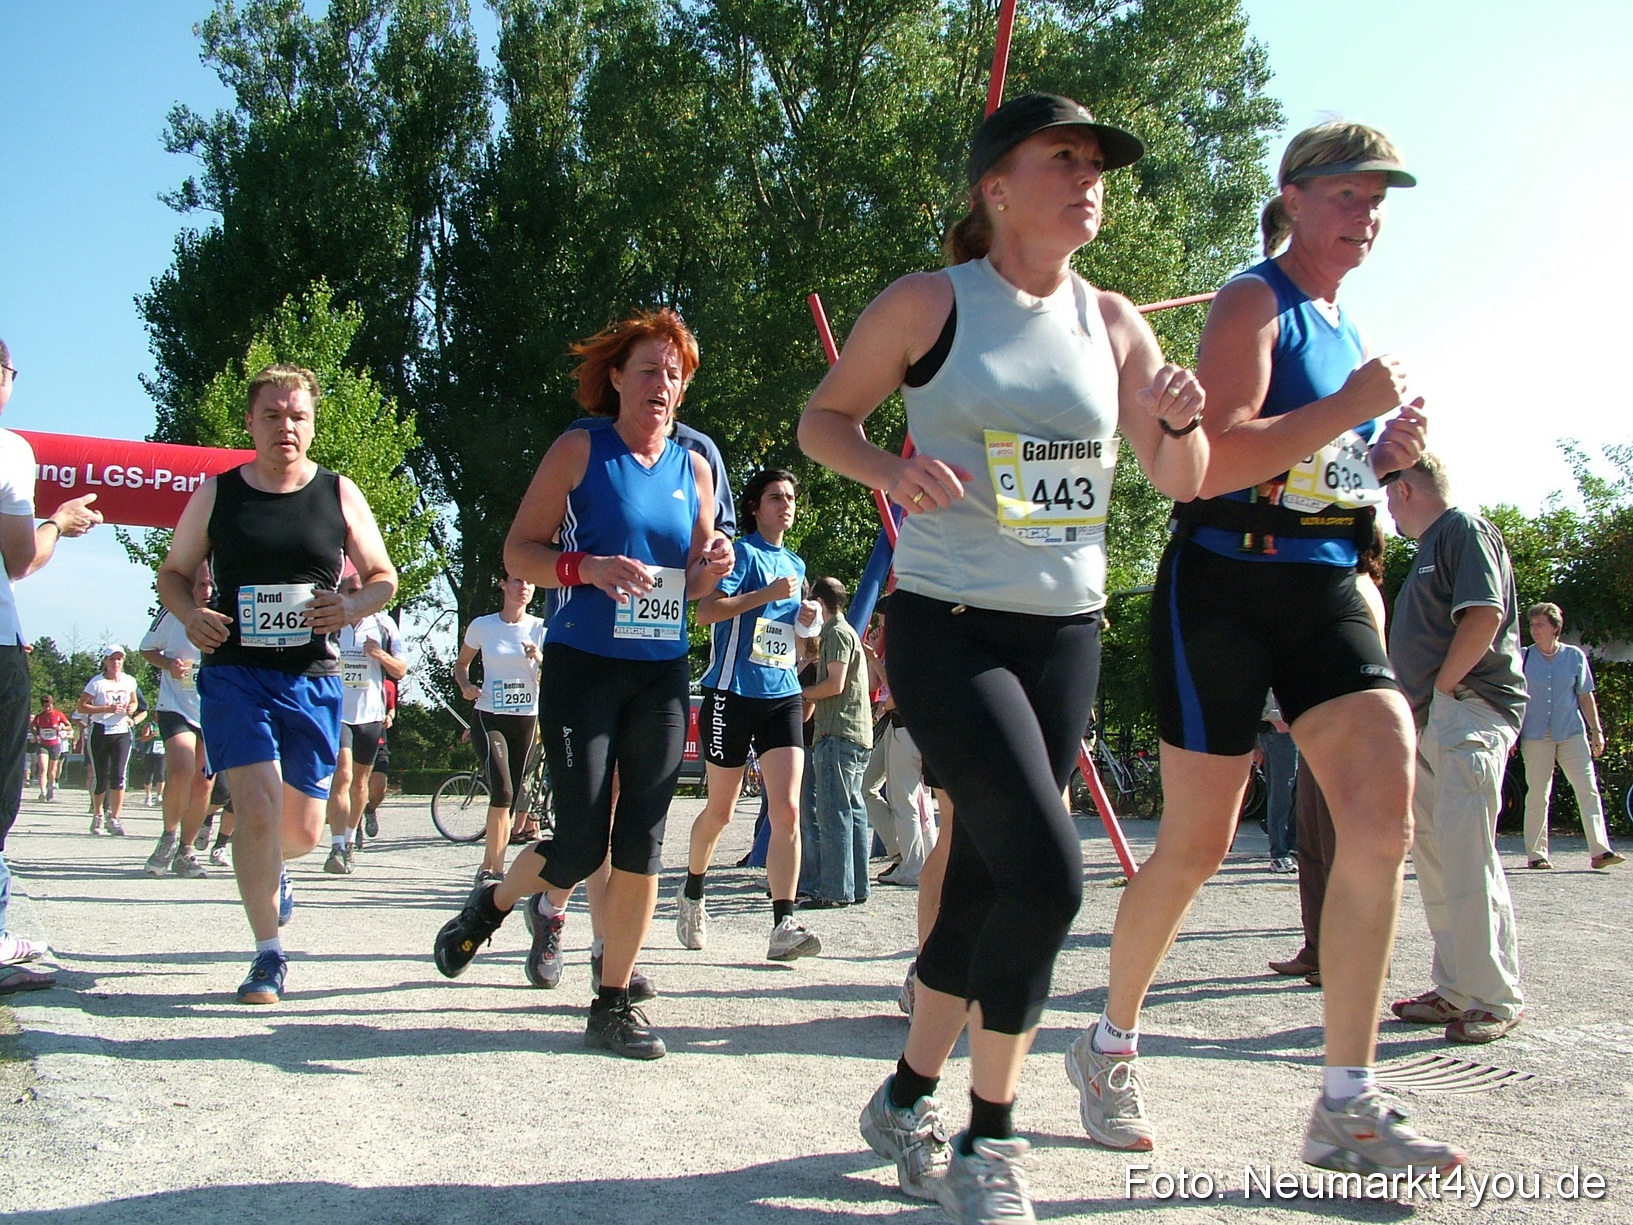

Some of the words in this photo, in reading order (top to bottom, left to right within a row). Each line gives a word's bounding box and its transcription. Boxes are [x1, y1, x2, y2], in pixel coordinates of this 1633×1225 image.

[1023, 441, 1102, 461] Gabriele
[1000, 473, 1014, 490] C
[1032, 477, 1095, 510] 443
[257, 591, 282, 603] Arnd
[243, 608, 251, 618] C
[638, 598, 680, 620] 2946
[765, 625, 782, 635] Liane
[766, 640, 787, 655] 132
[345, 672, 362, 681] 271
[505, 692, 532, 704] 2920
[710, 694, 727, 760] Sinupret
[1104, 1022, 1122, 1038] TECH
